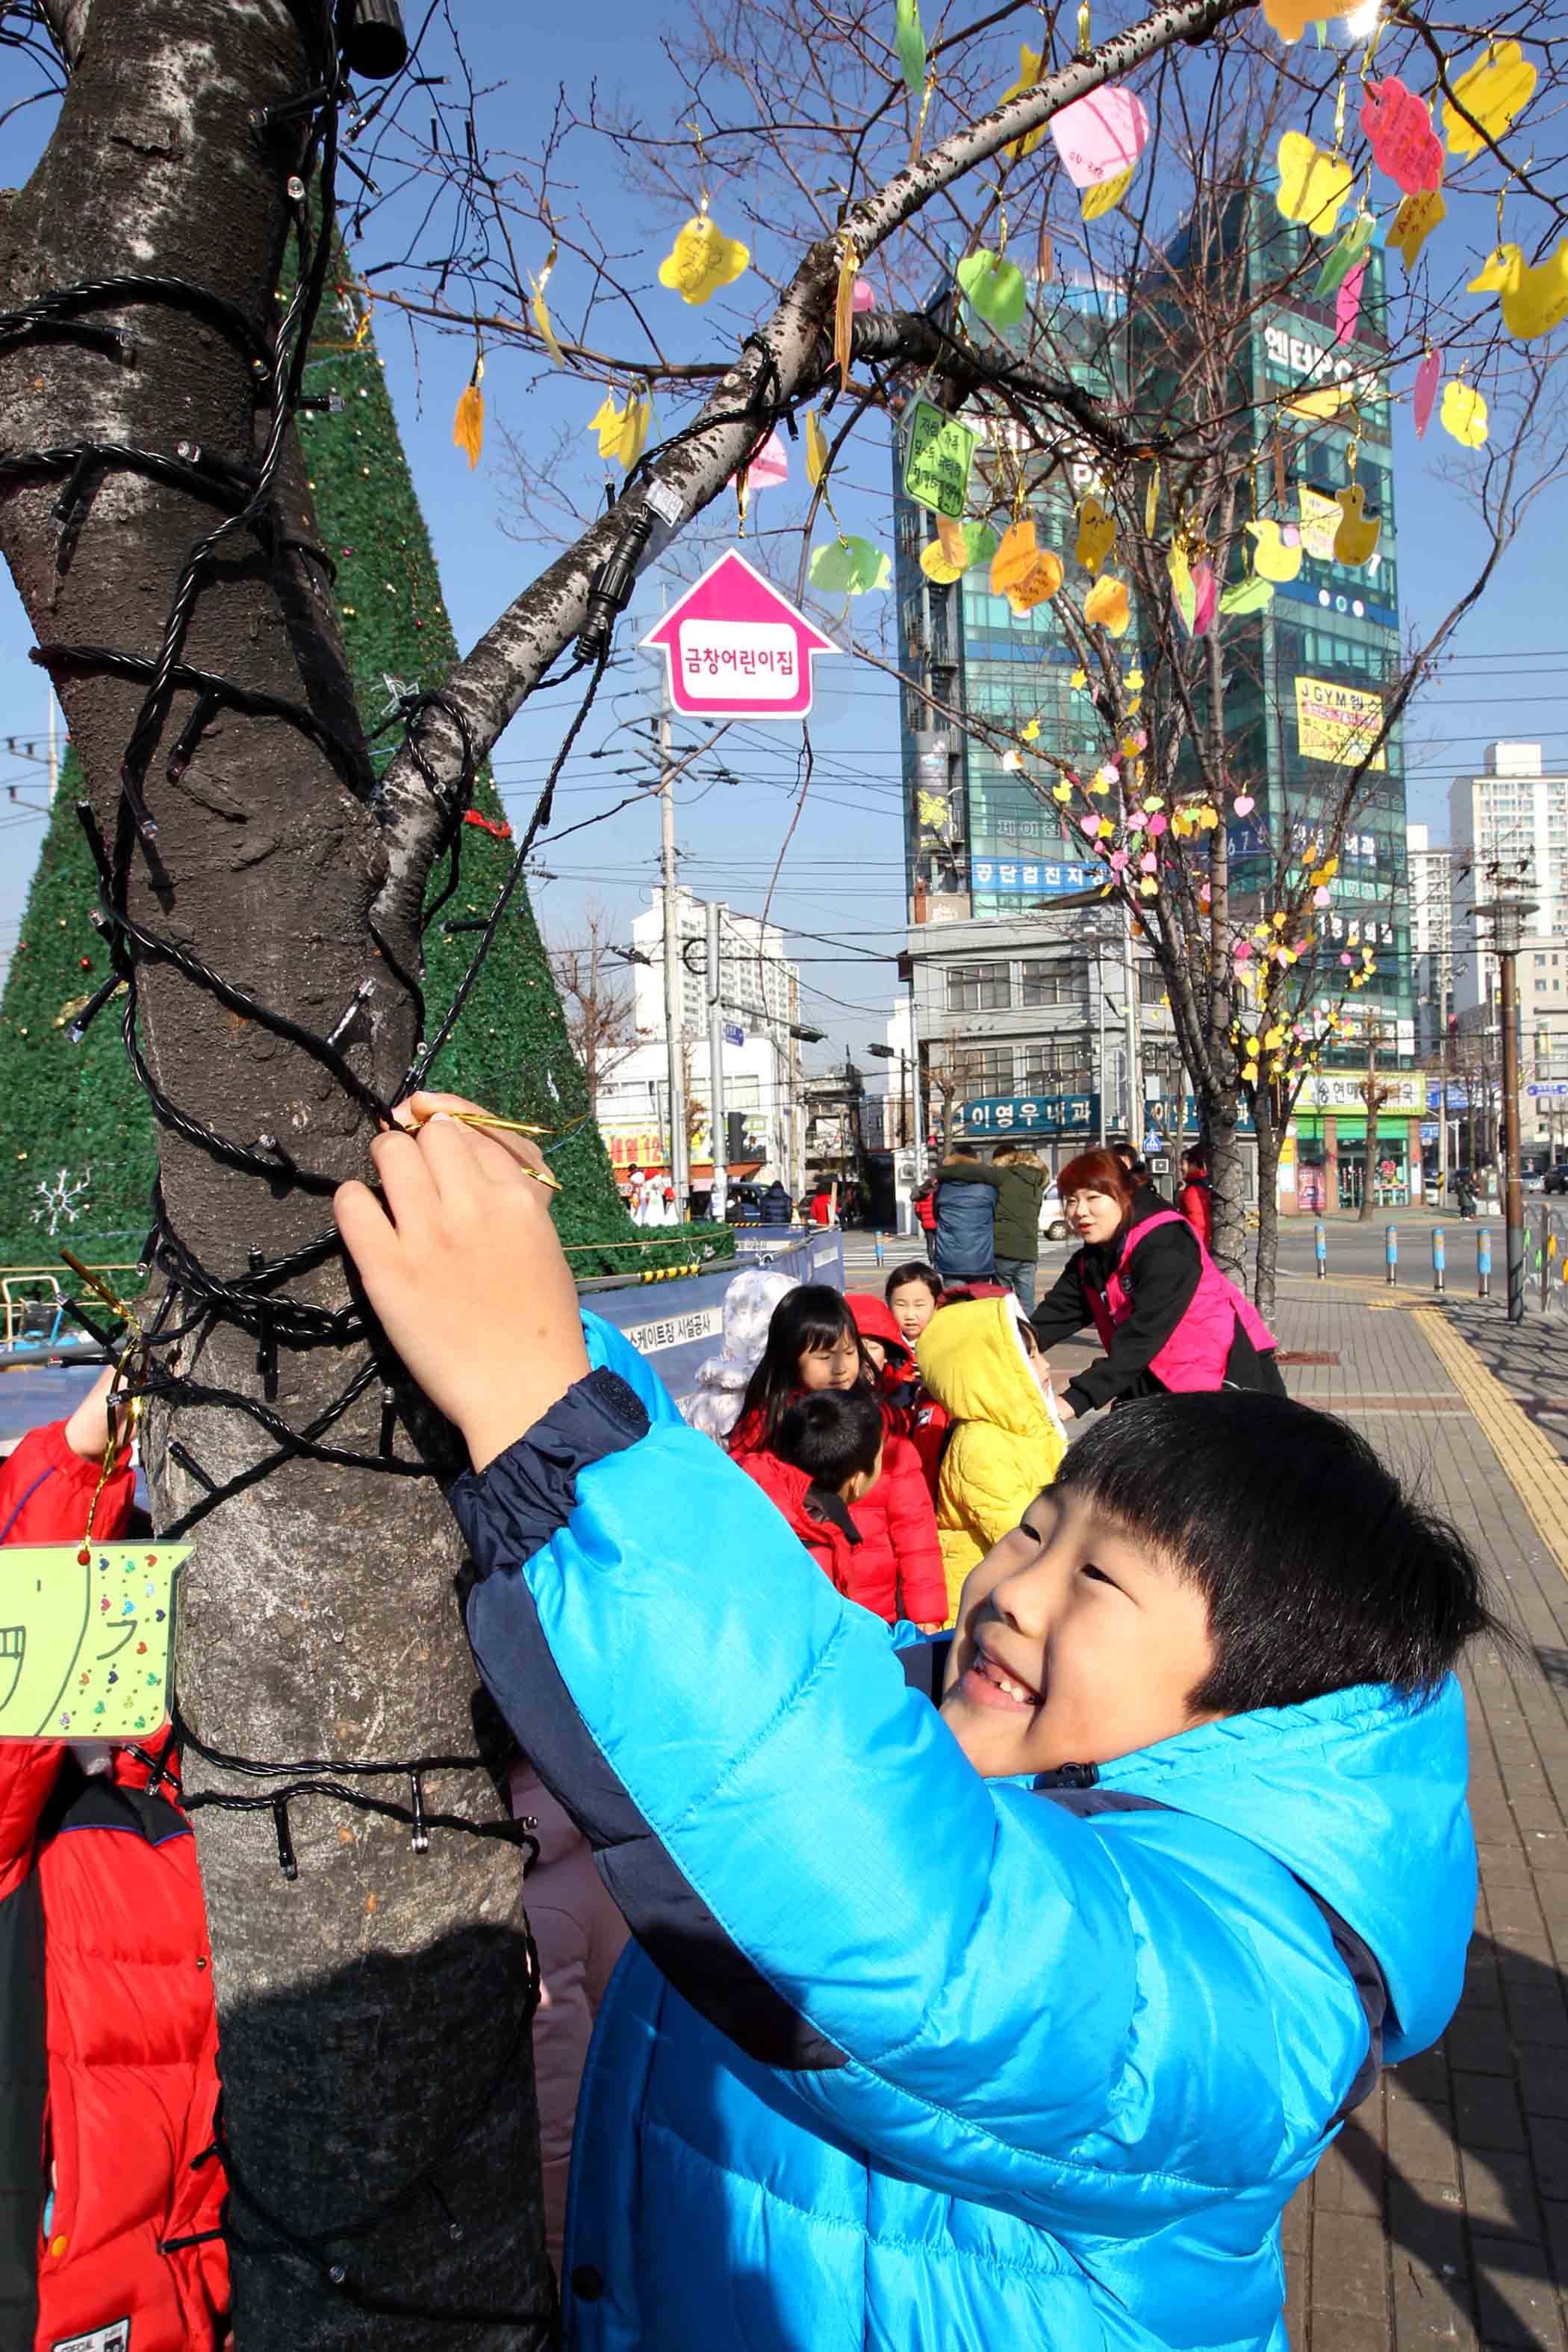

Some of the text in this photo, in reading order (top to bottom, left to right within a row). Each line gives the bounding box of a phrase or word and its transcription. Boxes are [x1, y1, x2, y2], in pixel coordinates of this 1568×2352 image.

[685, 648, 794, 676] 금창어린이집
[972, 1100, 1091, 1129] 이영우내과
[678, 1313, 711, 1338] 시설공사
